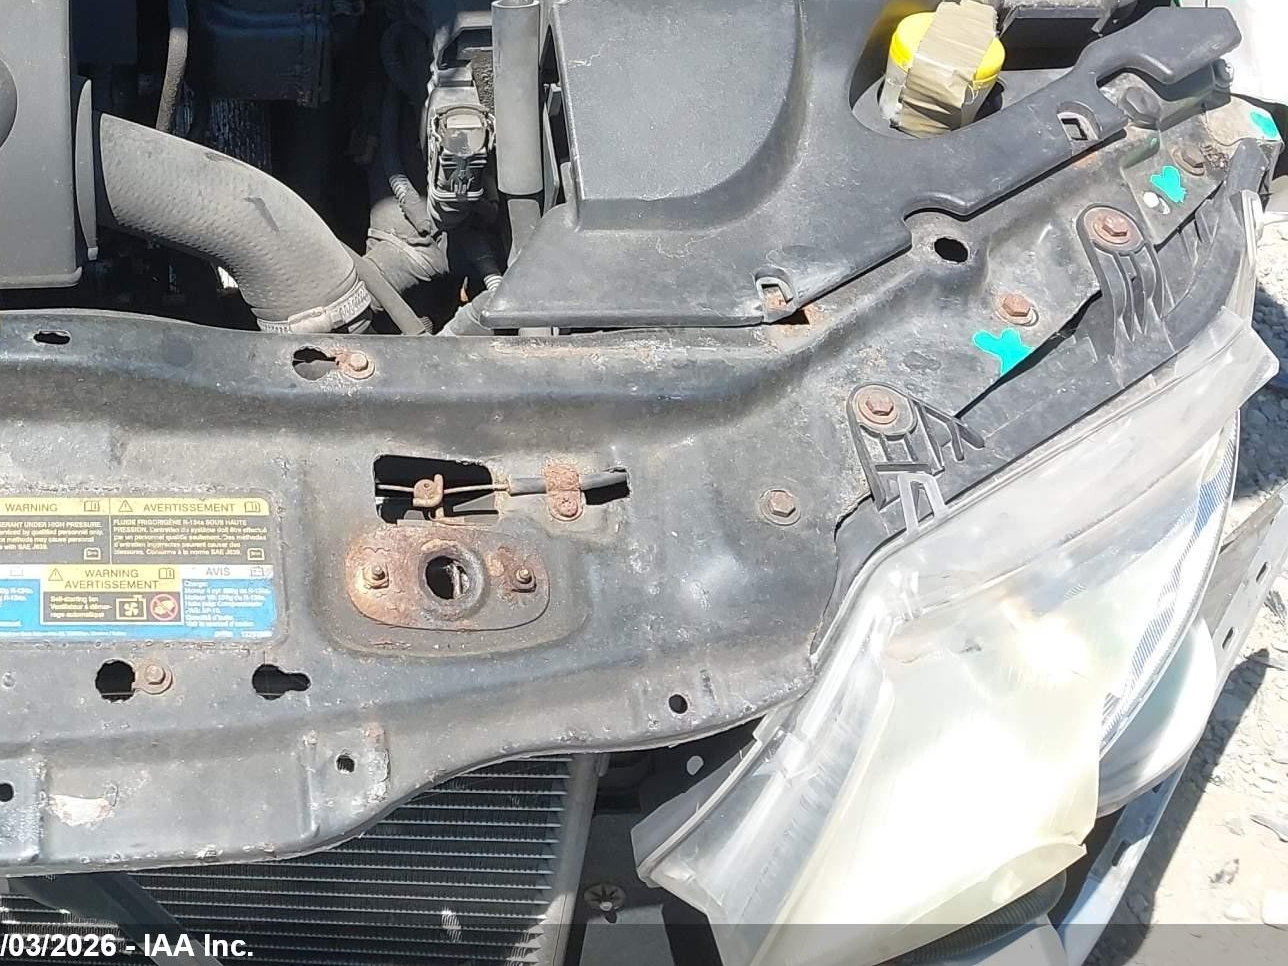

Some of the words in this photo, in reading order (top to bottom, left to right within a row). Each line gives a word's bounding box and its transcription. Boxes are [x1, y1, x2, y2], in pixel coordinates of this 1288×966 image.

[5, 503, 58, 512] WARNING
[143, 503, 235, 513] AVERTISSEMENT
[85, 569, 139, 578] WARNING
[206, 567, 231, 576] AVIS
[64, 580, 159, 589] AVERTISSEMENT
